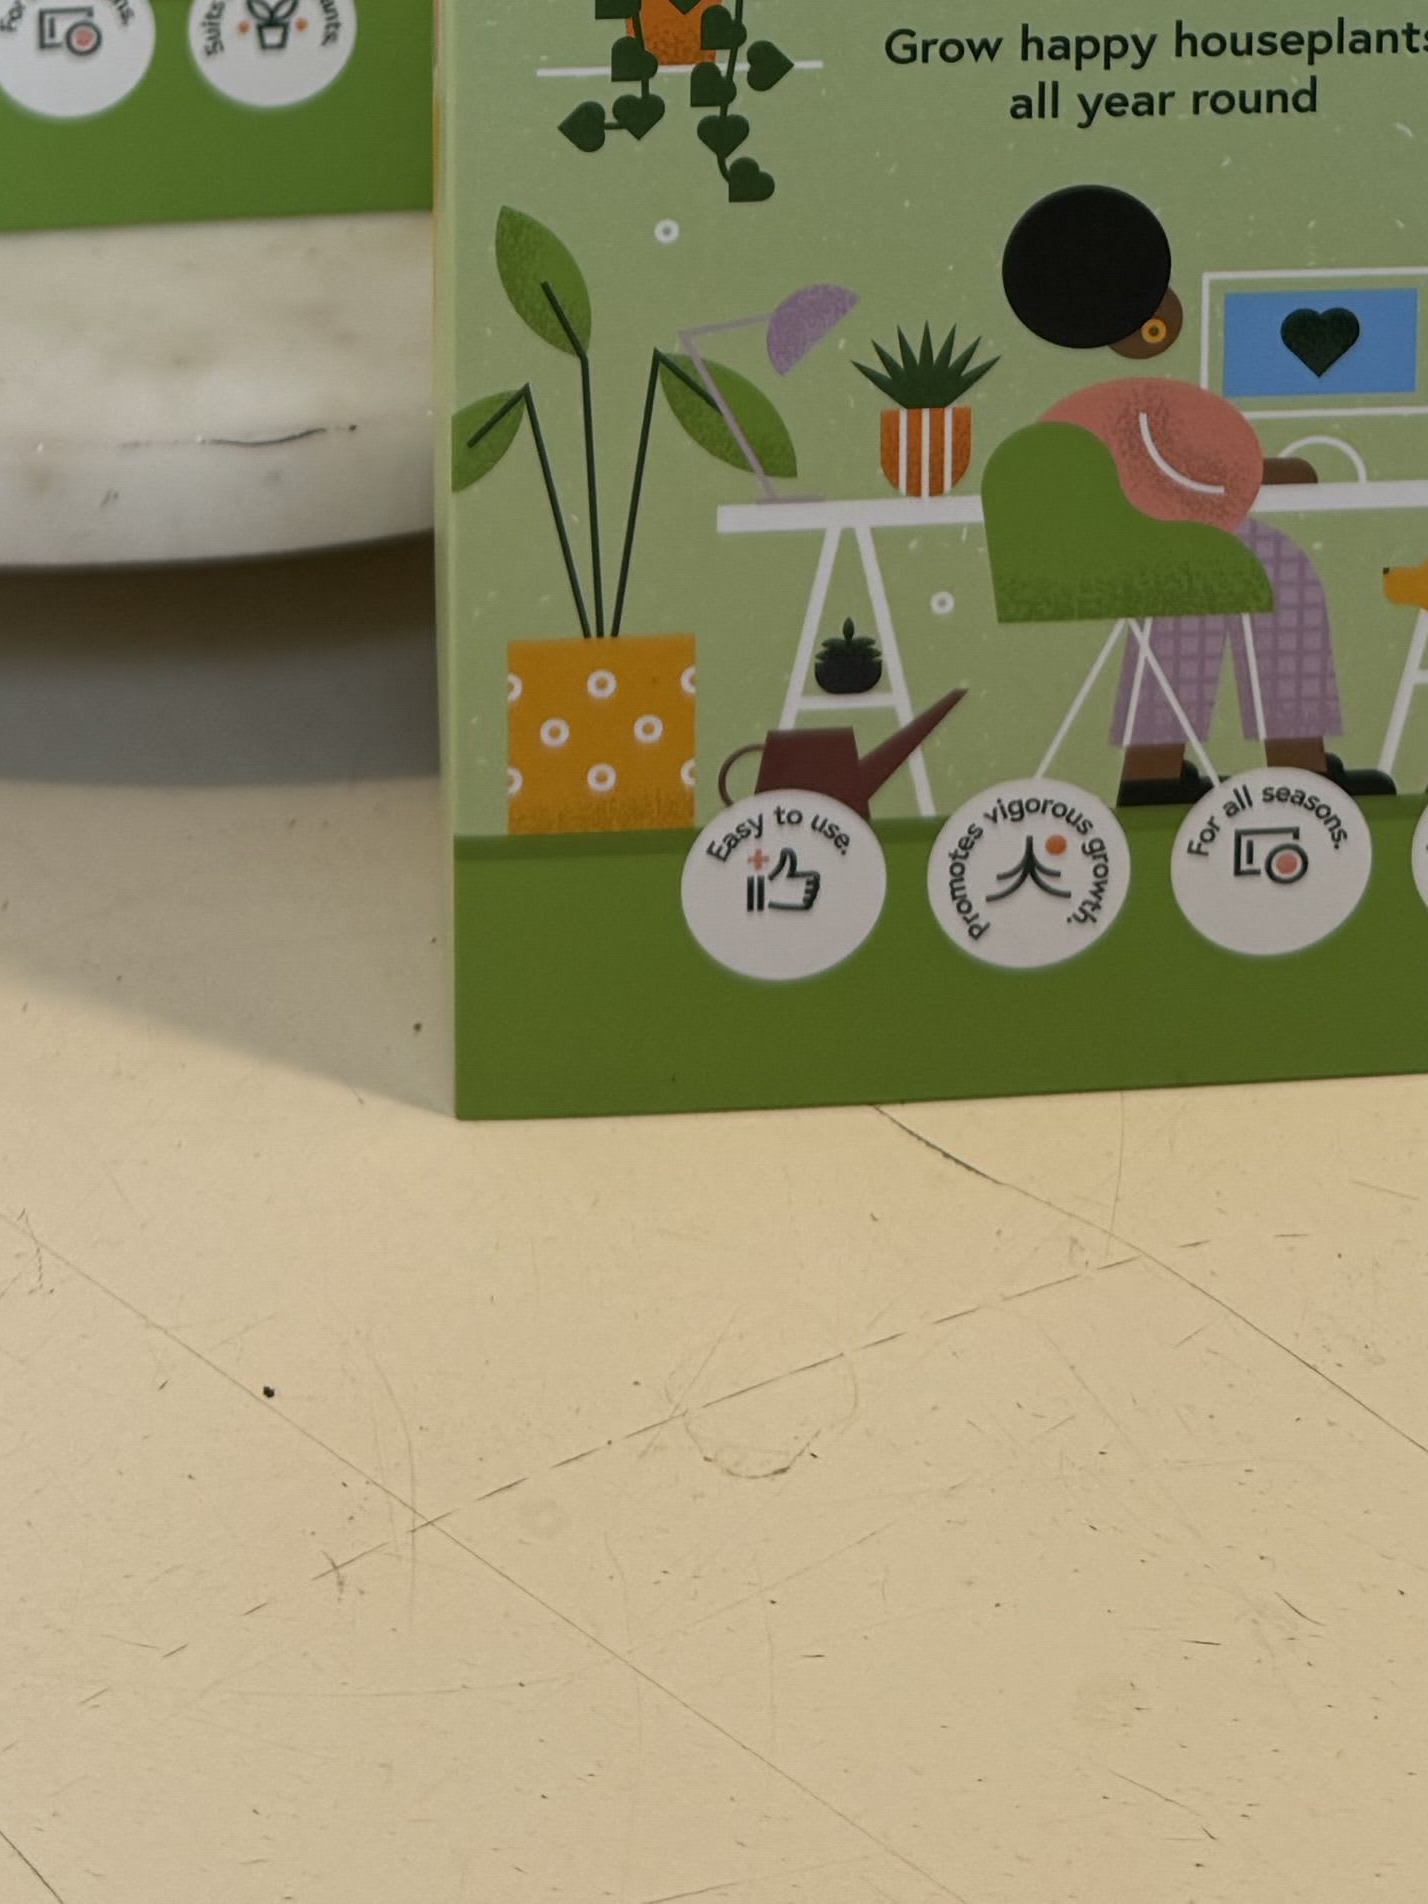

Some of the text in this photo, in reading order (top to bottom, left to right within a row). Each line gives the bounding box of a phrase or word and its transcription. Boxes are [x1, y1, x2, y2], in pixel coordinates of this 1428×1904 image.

[204, 0, 226, 58] Suits
[884, 29, 1002, 65] Grow
[1020, 23, 1156, 70] happy
[1010, 77, 1318, 127] all year round
[706, 806, 851, 862] Easy to use.
[1187, 784, 1347, 858] For all seasons.
[950, 797, 1109, 940] Promotes vigorous growth.
